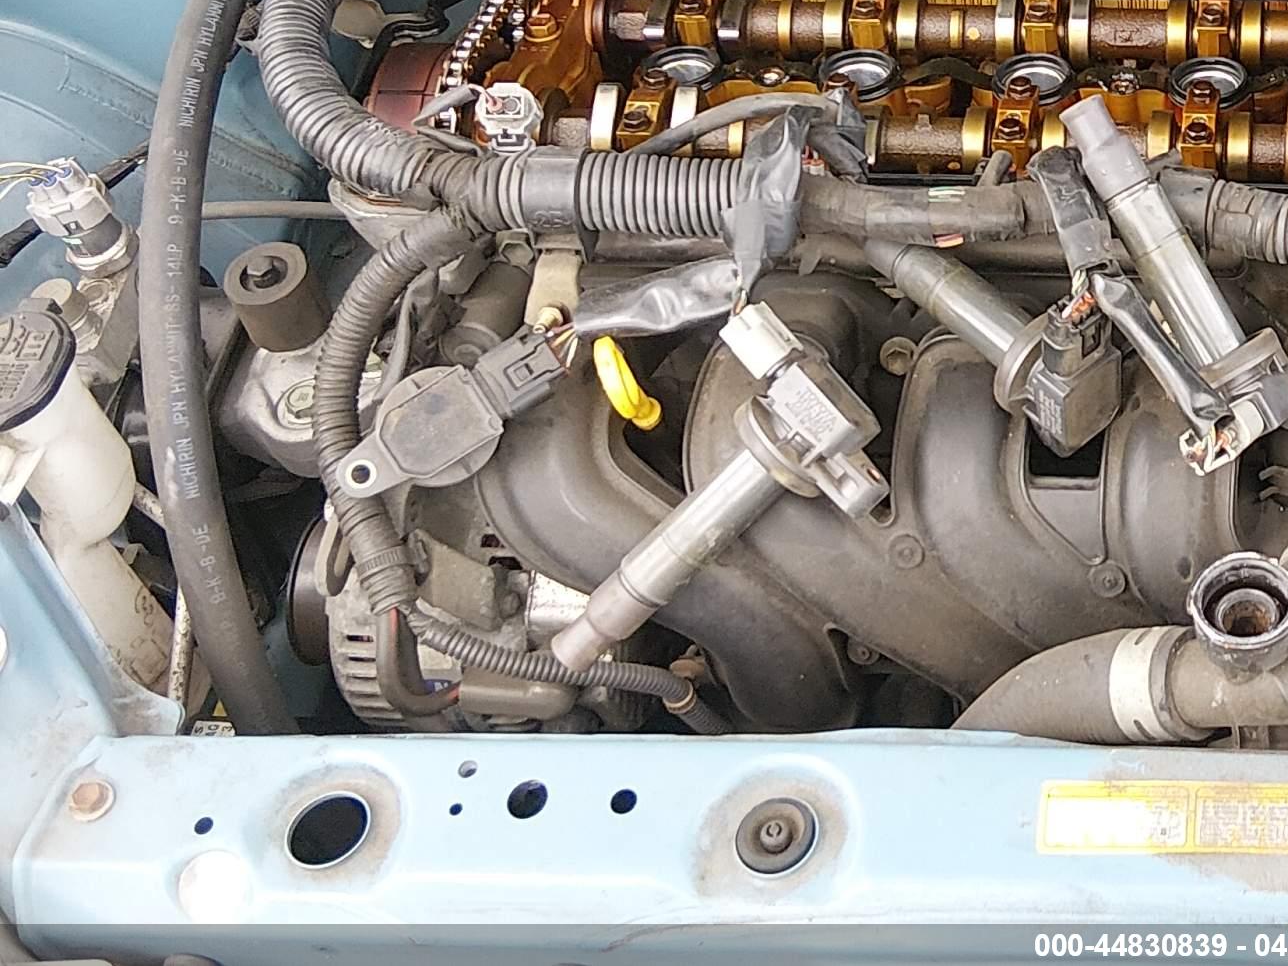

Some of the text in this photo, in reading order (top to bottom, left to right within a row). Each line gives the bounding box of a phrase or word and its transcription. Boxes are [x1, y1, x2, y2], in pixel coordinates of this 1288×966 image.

[178, 76, 201, 129] NICHIRIN
[193, 49, 207, 74] JPN
[171, 398, 190, 428] JPN
[175, 435, 201, 501] NICHIRIN
